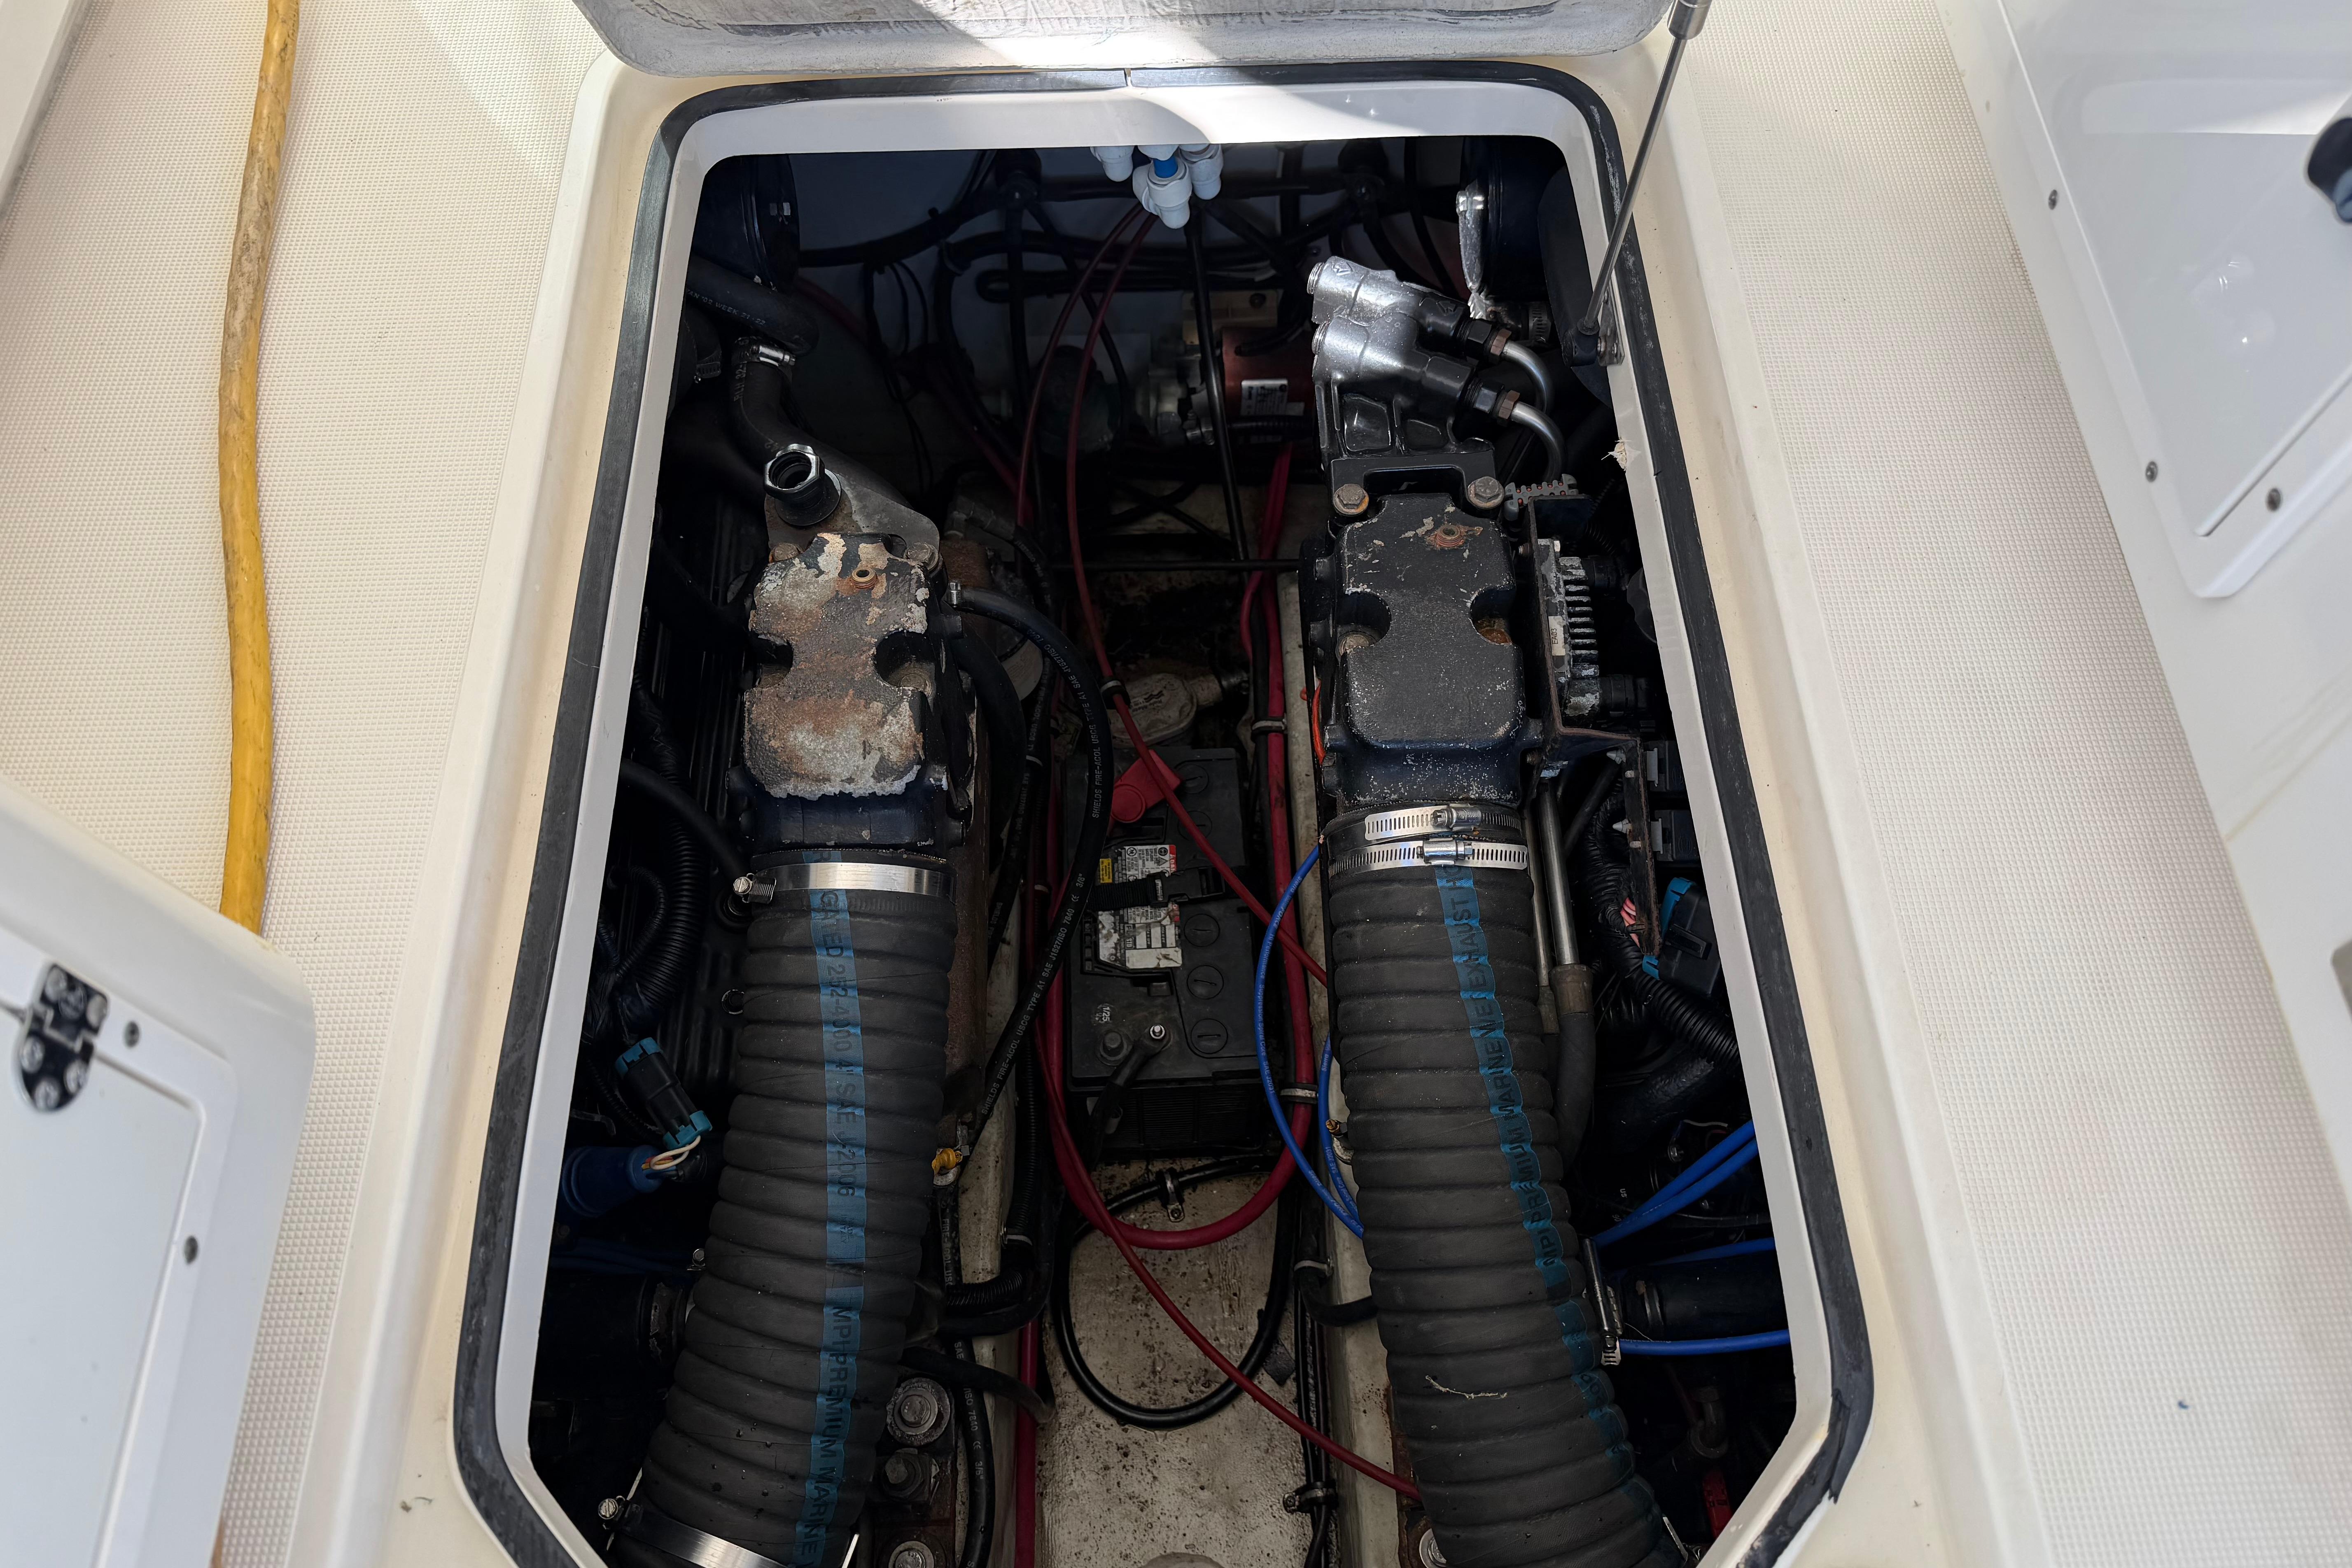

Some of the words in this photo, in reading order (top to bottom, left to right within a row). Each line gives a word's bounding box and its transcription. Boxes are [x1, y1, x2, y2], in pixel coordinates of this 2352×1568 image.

[715, 302, 740, 315] WEEK
[1068, 674, 1081, 689] SAE
[1082, 702, 1094, 722] TYPE
[1089, 724, 1101, 744] USCG
[1093, 747, 1103, 786] FIRE-ACOL
[1092, 789, 1103, 819] SHIELDS
[1450, 898, 1486, 988] EXHAUST
[827, 964, 852, 1051] 252-4000
[982, 1082, 1000, 1115] SHIELDS
[996, 1038, 1020, 1080] FIRE-ACOL
[1016, 1015, 1031, 1036] USCG
[1027, 992, 1041, 1011] TYPE
[1037, 980, 1046, 990] A1
[1042, 962, 1053, 978] SAE
[1049, 927, 1068, 961] J1527/ISO
[1063, 908, 1075, 925] 7840
[1075, 873, 1086, 889] 3/8"
[1257, 984, 1265, 1023] Suppression
[1102, 1006, 1111, 1022] 1/25
[1485, 1041, 1519, 1121] MARINE
[835, 1083, 857, 1124] SAE
[1507, 1126, 1547, 1224] PREMIUM
[832, 1307, 853, 1345] MPI
[954, 1341, 964, 1360] SAE
[819, 1353, 849, 1458] PREMIUM
[801, 1466, 835, 1556] MARINE
